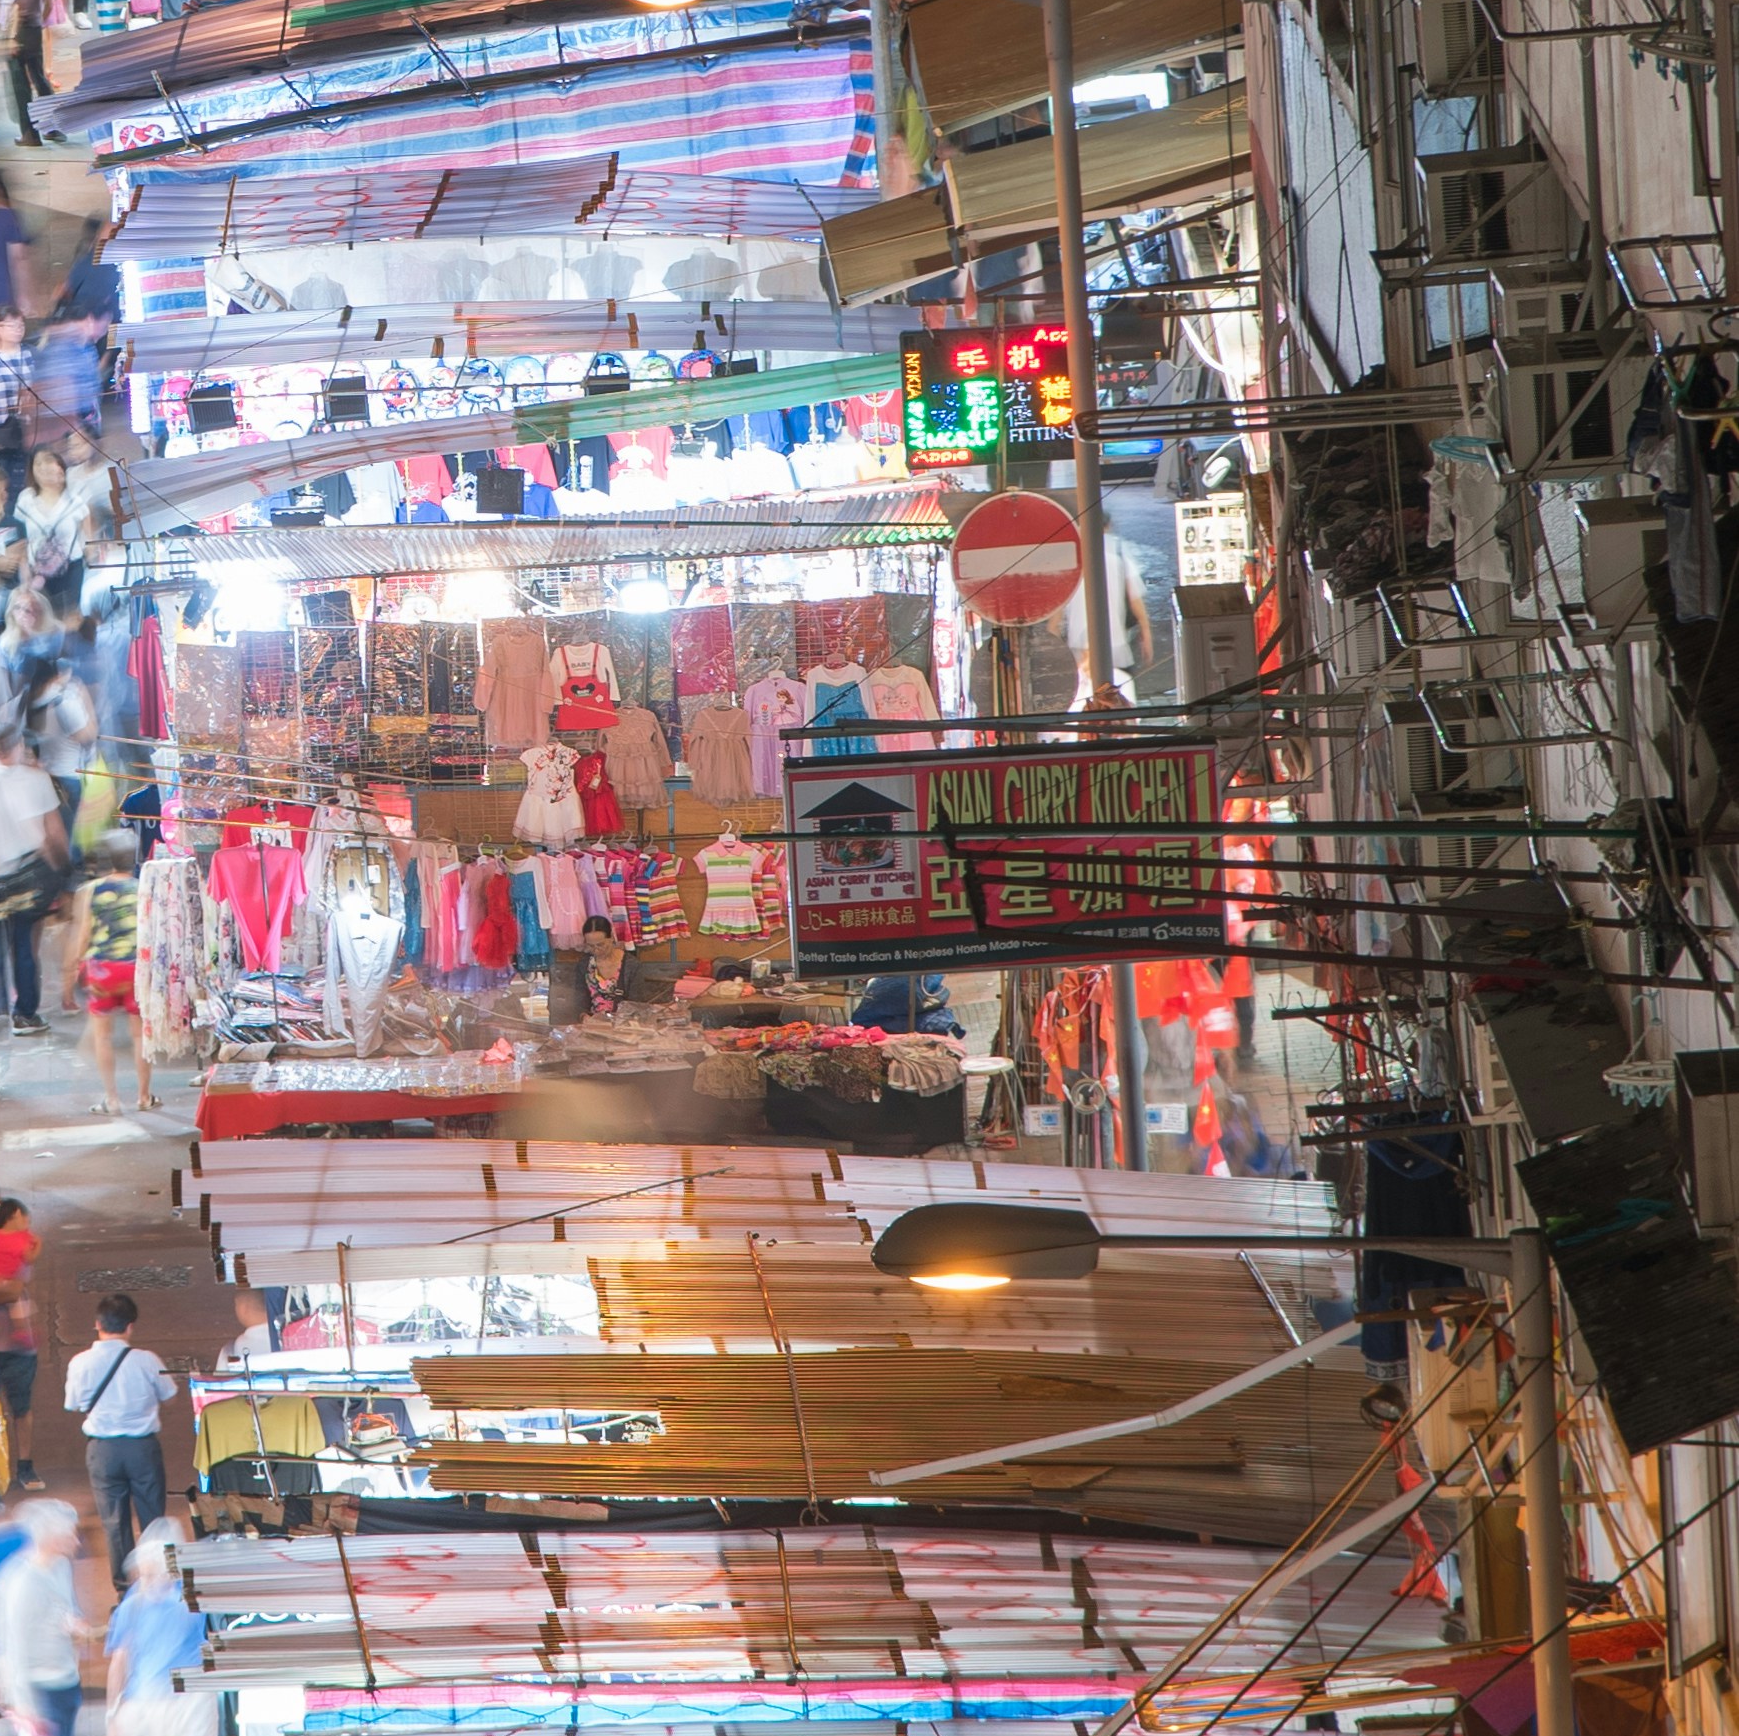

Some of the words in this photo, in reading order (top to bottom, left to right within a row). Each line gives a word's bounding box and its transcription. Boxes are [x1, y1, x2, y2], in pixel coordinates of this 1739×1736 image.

[905, 352, 922, 400] NOKIA
[926, 768, 993, 836] ASIAN
[1003, 763, 1079, 828] CURRY
[1089, 757, 1188, 826] KITCHEN
[805, 875, 835, 888] ASIAN
[838, 873, 871, 886] CURRY
[874, 871, 916, 884] KITCHEN
[1168, 926, 1194, 937] 3542
[1195, 926, 1221, 937] 5575
[798, 951, 828, 963] Better
[829, 952, 858, 964] Taste
[859, 950, 892, 962] Indian
[894, 949, 902, 960] &
[904, 946, 954, 961] Nepalese
[956, 942, 988, 954] Home
[989, 939, 1021, 951] Made
